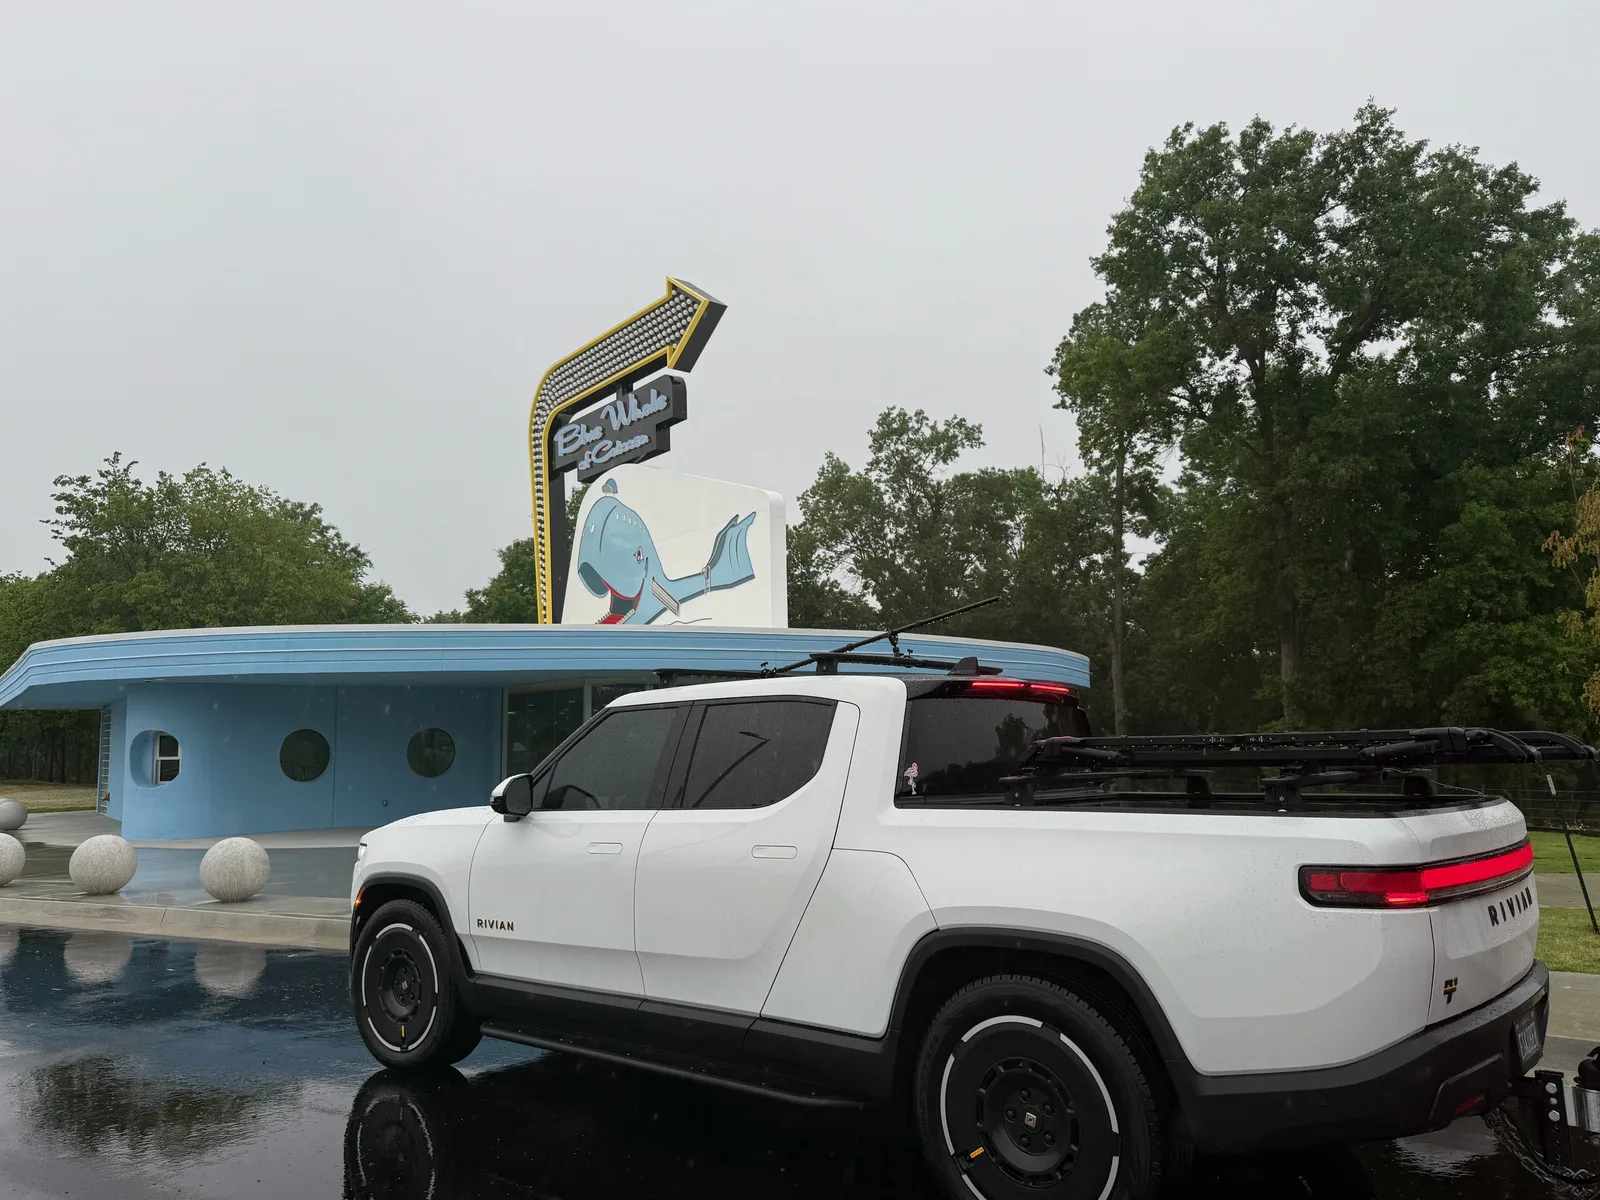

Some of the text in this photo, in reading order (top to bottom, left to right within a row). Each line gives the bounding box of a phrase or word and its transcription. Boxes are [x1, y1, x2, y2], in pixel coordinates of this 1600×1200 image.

[553, 388, 667, 457] Blue Whale
[578, 450, 592, 471] of
[1487, 886, 1533, 927] RIVIAN
[476, 918, 515, 932] RIVIAN
